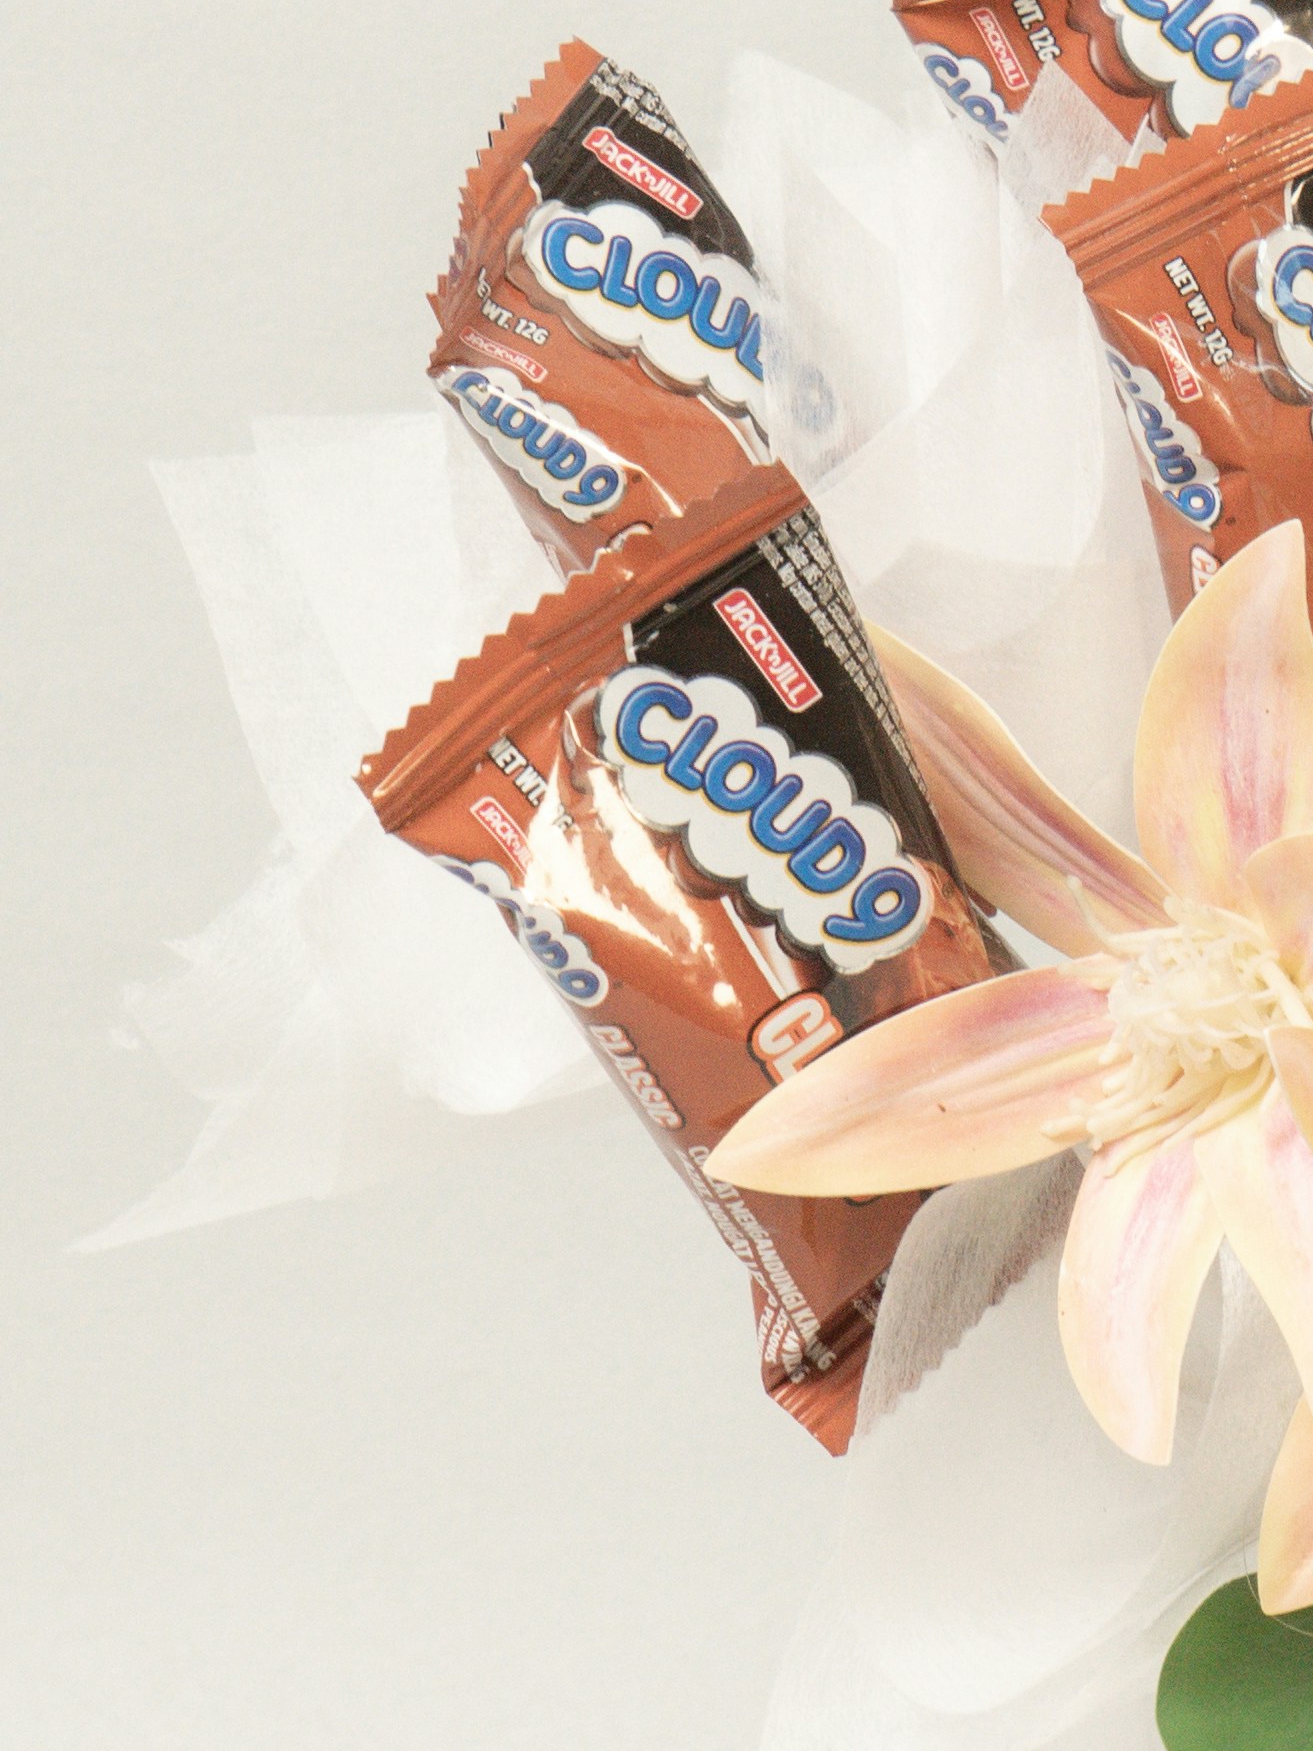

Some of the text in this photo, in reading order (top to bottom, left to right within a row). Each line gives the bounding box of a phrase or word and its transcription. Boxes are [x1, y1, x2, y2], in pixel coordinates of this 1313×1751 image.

[1029, 26, 1061, 62] 12G
[924, 55, 1008, 143] CLO
[514, 316, 550, 346] 12G
[1164, 256, 1233, 367] NET WT. 12G
